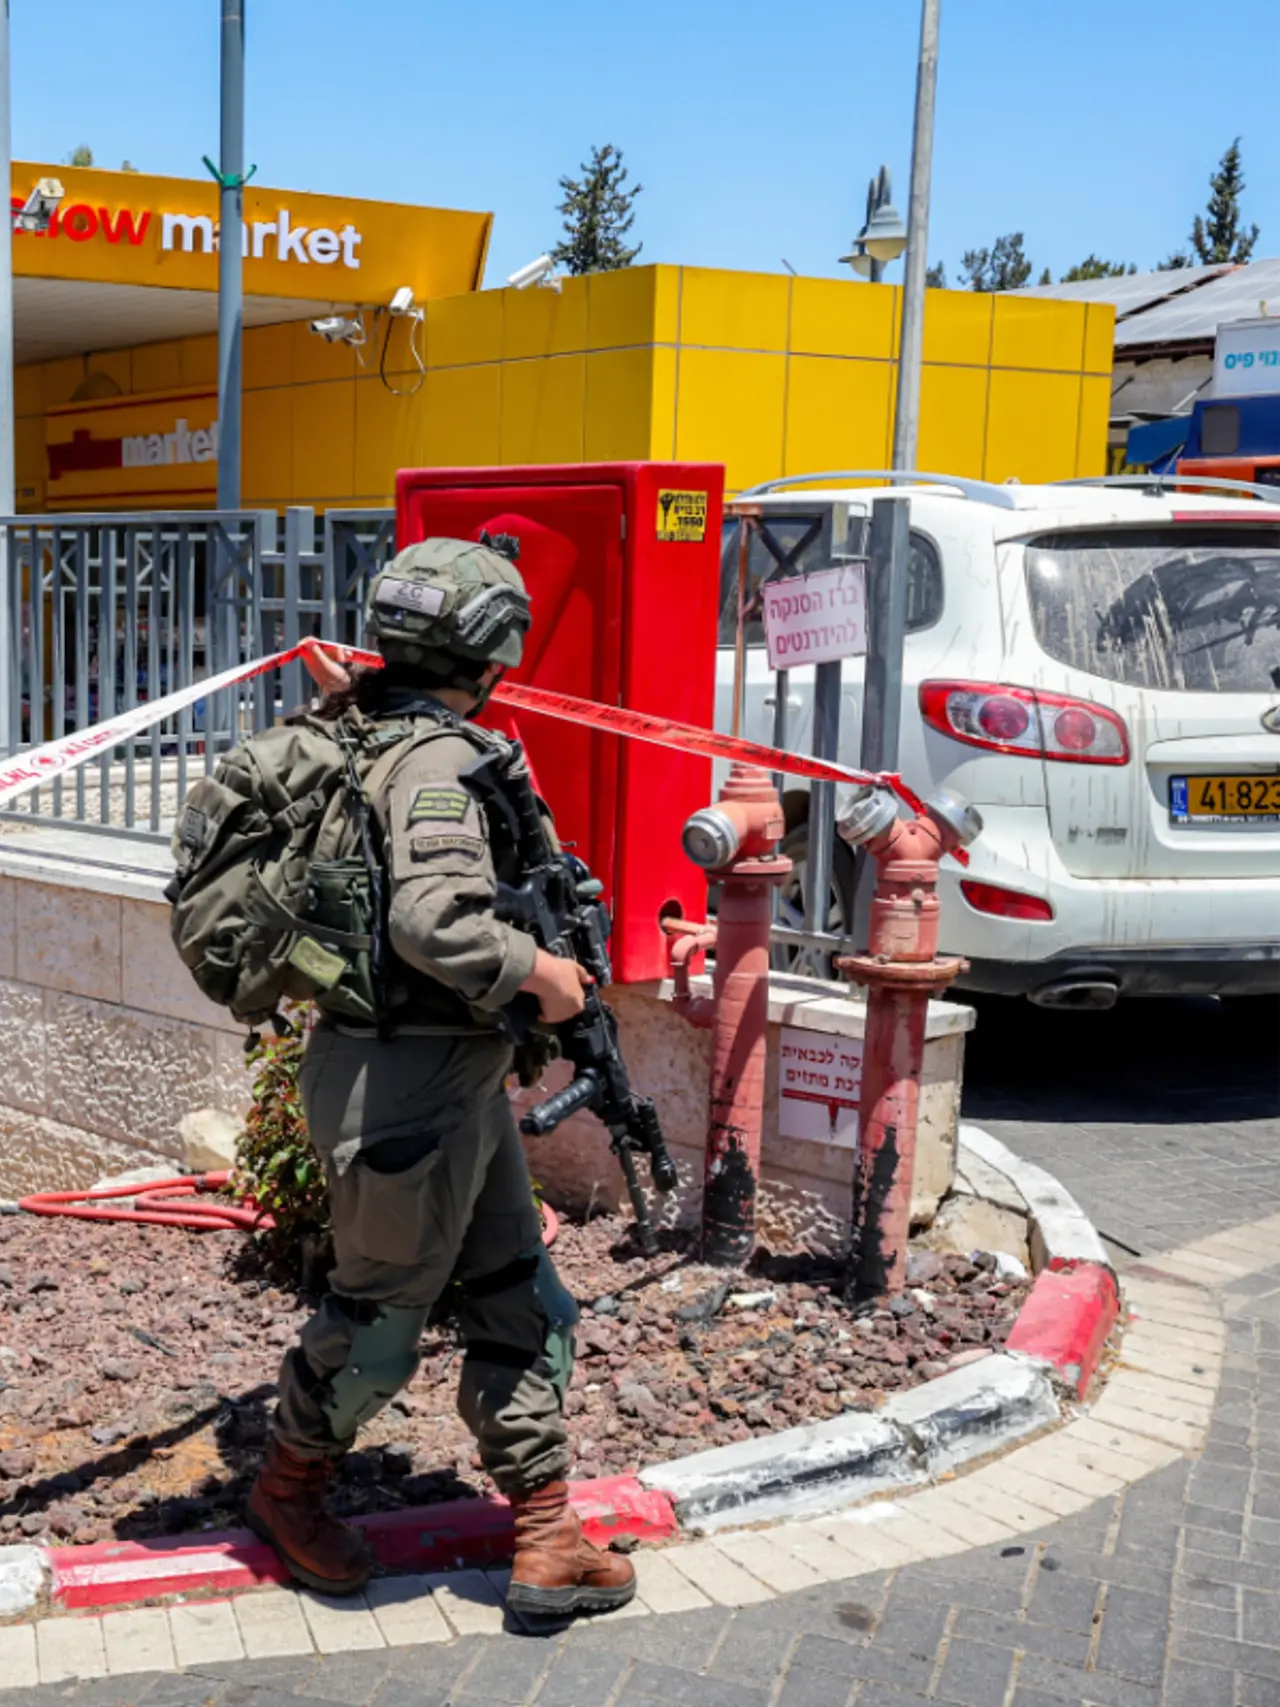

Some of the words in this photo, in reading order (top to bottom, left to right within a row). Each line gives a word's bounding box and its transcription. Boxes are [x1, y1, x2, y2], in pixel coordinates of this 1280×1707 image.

[1224, 351, 1255, 370] פיס
[770, 591, 823, 623] הסנקה
[827, 585, 858, 608] ברז
[776, 617, 857, 655] להידרנטים
[782, 1045, 835, 1065] לכבאית
